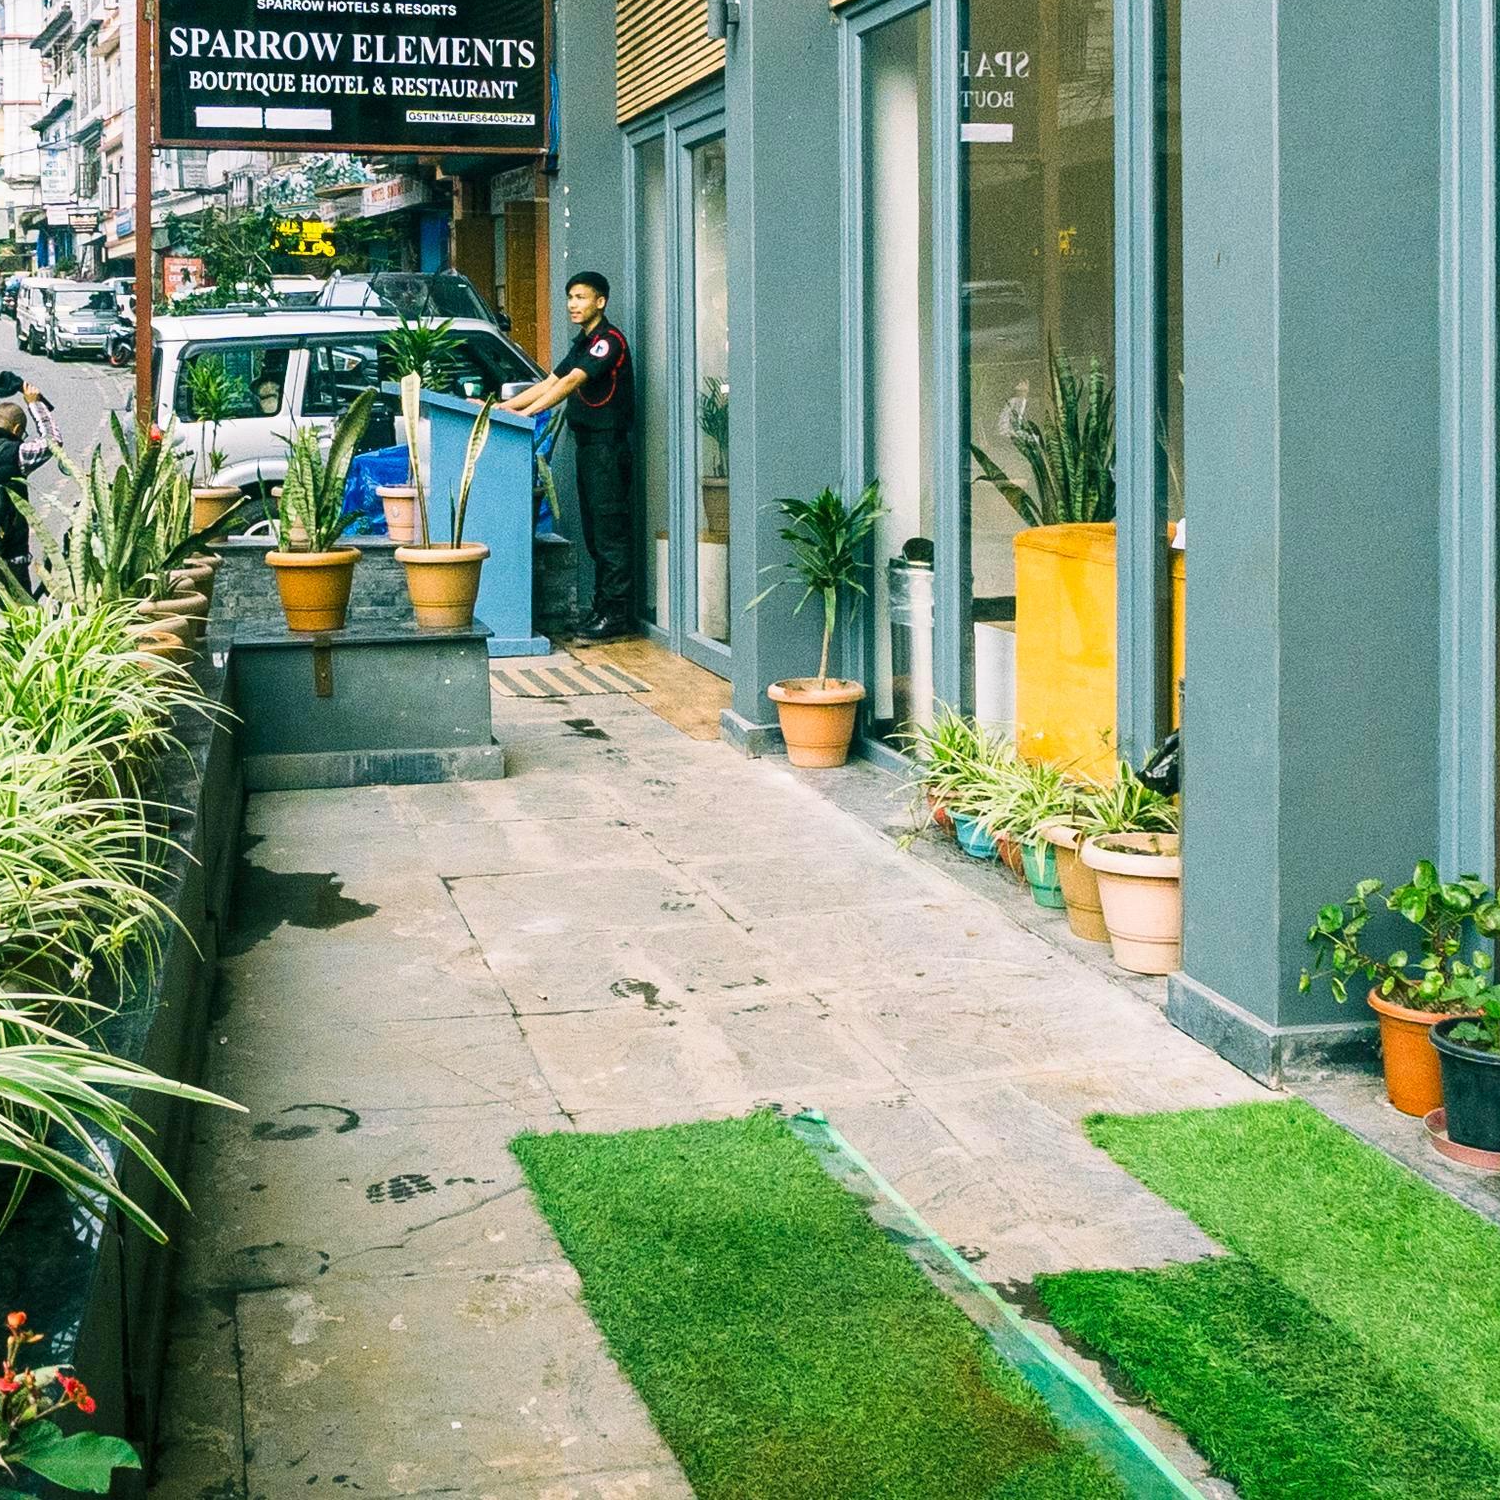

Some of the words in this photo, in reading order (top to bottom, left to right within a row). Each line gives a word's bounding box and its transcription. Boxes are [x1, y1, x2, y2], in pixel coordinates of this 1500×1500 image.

[327, 0, 380, 14] HOTELS
[382, 2, 393, 14] &
[395, 2, 457, 17] RESORTS
[169, 26, 343, 62] SPARROW
[352, 33, 536, 69] ELEMENTS
[189, 70, 296, 97] BOUTIQUE
[300, 73, 369, 95] HOTEL
[372, 76, 387, 96] &
[391, 76, 518, 100] RESTAURANT
